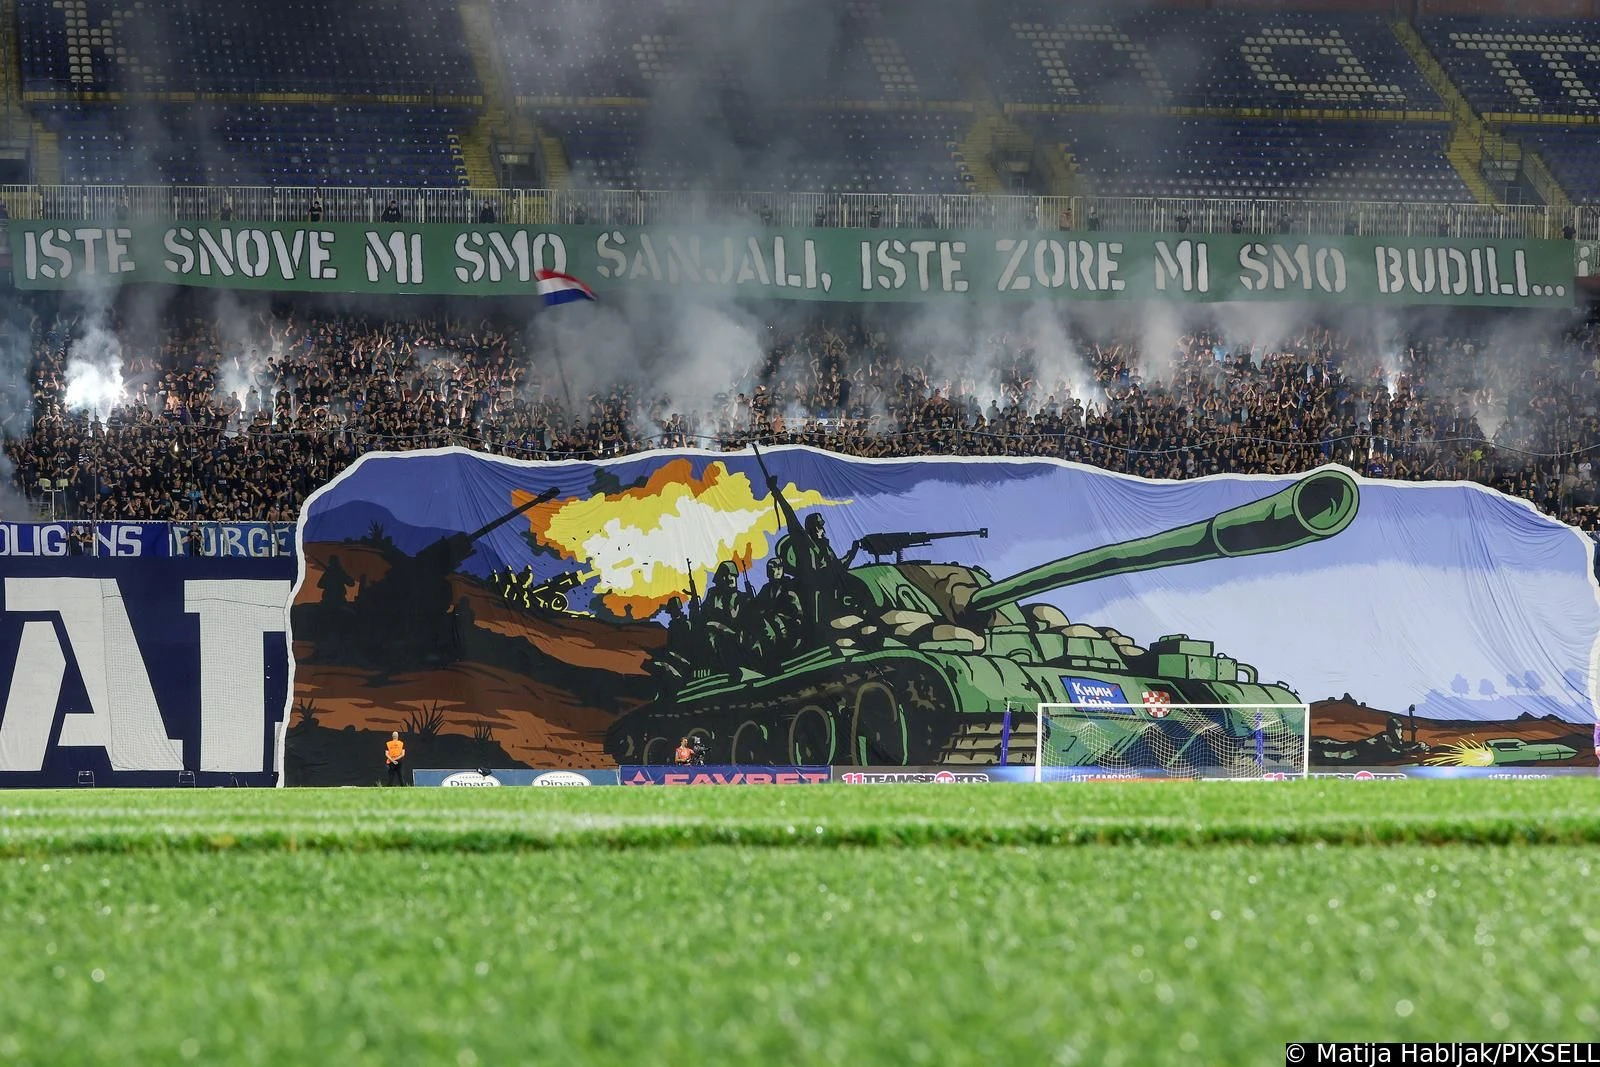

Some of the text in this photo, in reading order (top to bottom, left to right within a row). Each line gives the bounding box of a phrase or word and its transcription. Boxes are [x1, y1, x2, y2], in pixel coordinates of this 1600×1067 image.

[24, 228, 136, 280] ISTE
[164, 228, 338, 280] SNOVE
[365, 230, 424, 284] MI
[455, 230, 568, 283] SMO
[596, 230, 834, 294] SANJALI,
[861, 239, 969, 292] ISTE
[995, 238, 1127, 292] ZORE
[1153, 240, 1209, 293] MI
[1239, 242, 1348, 294] SMO
[1375, 245, 1566, 297] BUDILI...
[0, 524, 143, 557] LIGNS
[1071, 682, 1114, 698] Книн
